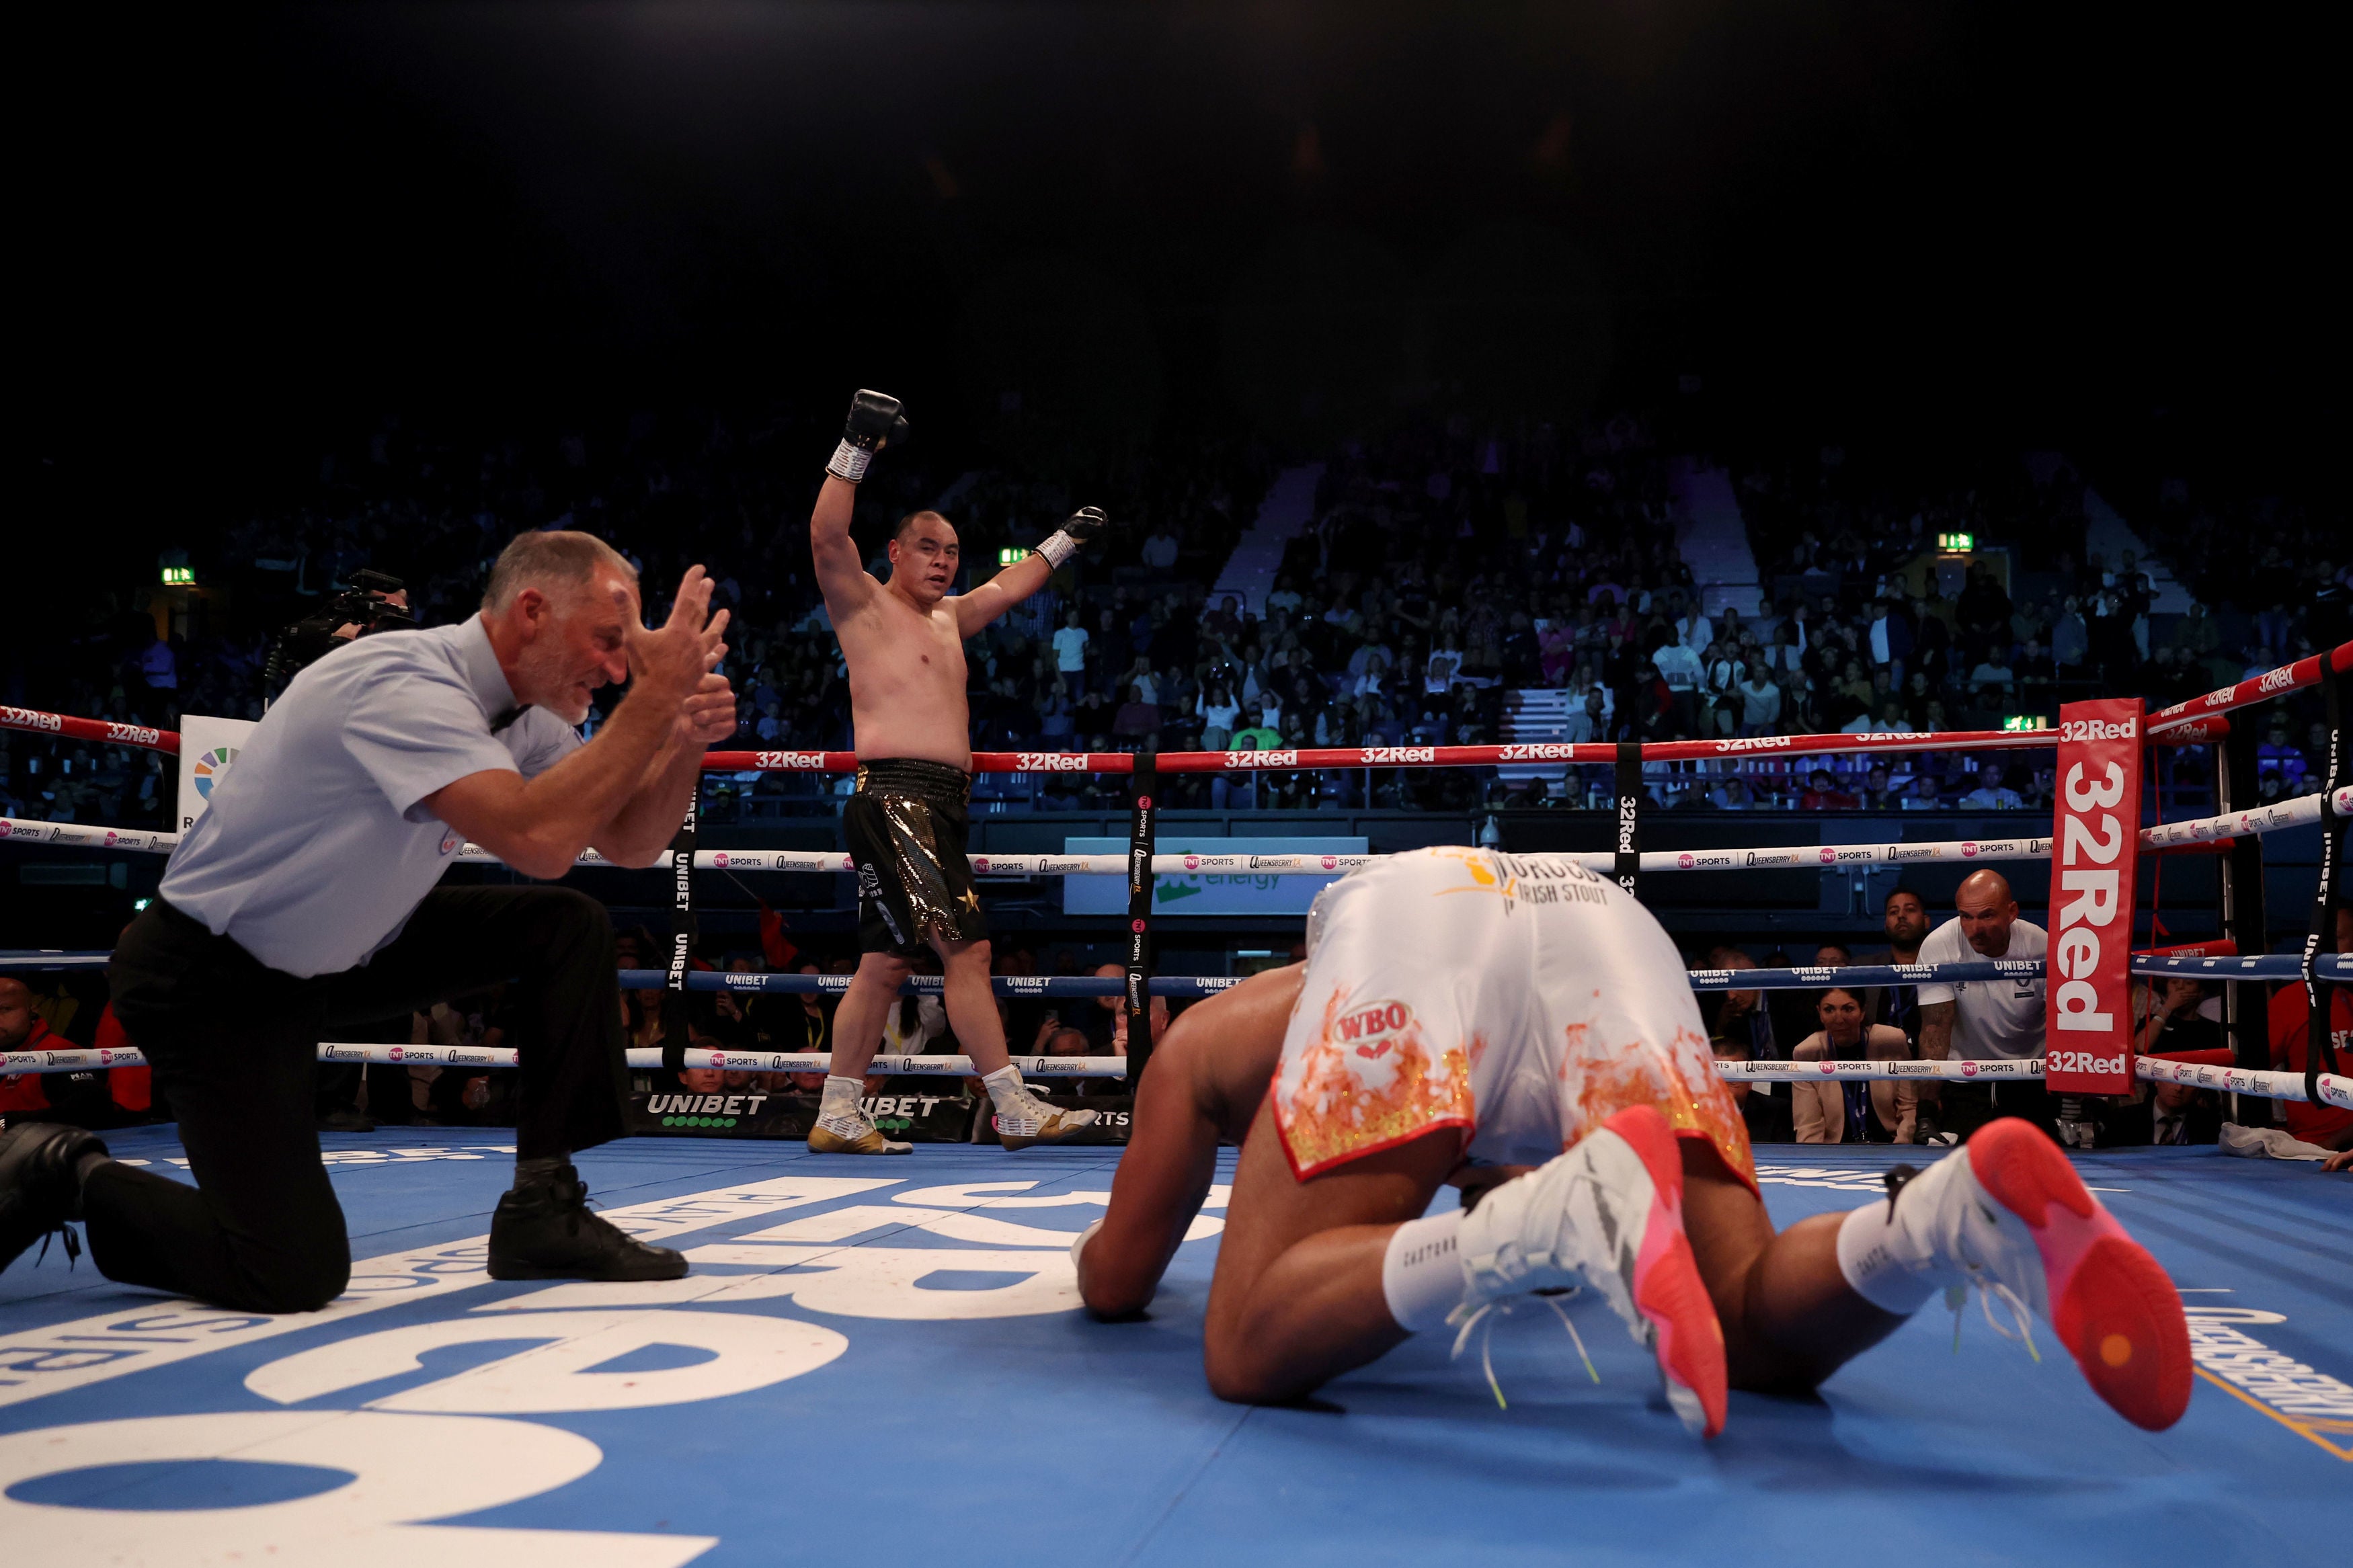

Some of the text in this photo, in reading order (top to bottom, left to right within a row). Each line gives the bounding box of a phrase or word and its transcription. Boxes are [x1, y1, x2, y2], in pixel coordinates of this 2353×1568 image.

[2259, 663, 2295, 693] 32Red
[2205, 685, 2237, 706] 32Red
[1, 706, 62, 731] 32Red
[107, 722, 160, 745] 32Red
[2061, 717, 2137, 742] 32Red
[1224, 749, 1298, 768] 32Red
[1360, 747, 1435, 763] 32Red
[1499, 743, 1574, 759] 32Red
[755, 751, 826, 768] 32Red
[1016, 753, 1088, 771] 32Red
[2323, 729, 2338, 802] UNIBET
[12, 827, 40, 837] SPORTS
[1139, 811, 1147, 837] SPORTS
[1620, 796, 1636, 854] 32Red
[117, 837, 141, 846] SPORTS
[1961, 844, 2013, 854] TNT SPORTS
[1321, 857, 1337, 867] TNT
[1678, 852, 1790, 867] TNT SPORTS QUEENSBERRY
[1819, 846, 1932, 862] TNT SPORTS QUEENSBERRY
[713, 856, 817, 870] TNT SPORTS QUEENSBERRY
[975, 861, 990, 872] TNT
[1039, 858, 1081, 872] QUEENSBERRY
[1133, 849, 1147, 885] QUEENSBERRY
[1184, 857, 1199, 867] TNT
[1250, 856, 1293, 869] QUEENSBERRY
[676, 854, 689, 911] UNIBET
[1518, 882, 1558, 904] IRISH
[1562, 884, 1607, 905] STOUT
[2056, 761, 2124, 1032] 32Red
[1133, 935, 1141, 961] SPORTS
[669, 934, 687, 990] UNIBET
[1892, 964, 1939, 973] UNIBET
[1994, 960, 2041, 971] UNIBET
[1690, 969, 1737, 978] UNIBET
[1792, 966, 1838, 975] UNIBET
[2301, 934, 2319, 1007] UNIBET
[725, 975, 768, 985] UNIBET
[818, 977, 854, 986] UNIBE
[1006, 977, 1051, 987] UNIBET
[1339, 1003, 1406, 1040] WBO
[8, 1055, 36, 1063] SPORTS
[325, 1045, 487, 1063] QUEENSBERRY TNT SPORTS QUEENSBERRY
[710, 1055, 813, 1069] TNT SPORTS QUEENSBERRY
[2048, 1050, 2126, 1074] 32Red
[903, 1058, 944, 1072] QUEENSBERRY
[1036, 1059, 1078, 1073] QUEENSBERRY
[1745, 1061, 1790, 1073] QUEENSBERRY
[1819, 1062, 1835, 1072] TNT
[1888, 1062, 1932, 1074] QUEENSBERRY
[1961, 1063, 1978, 1074] TNT
[2230, 1077, 2245, 1087] SPORTS
[2330, 1086, 2348, 1100] SPORTS
[648, 1095, 767, 1116] UNIBET
